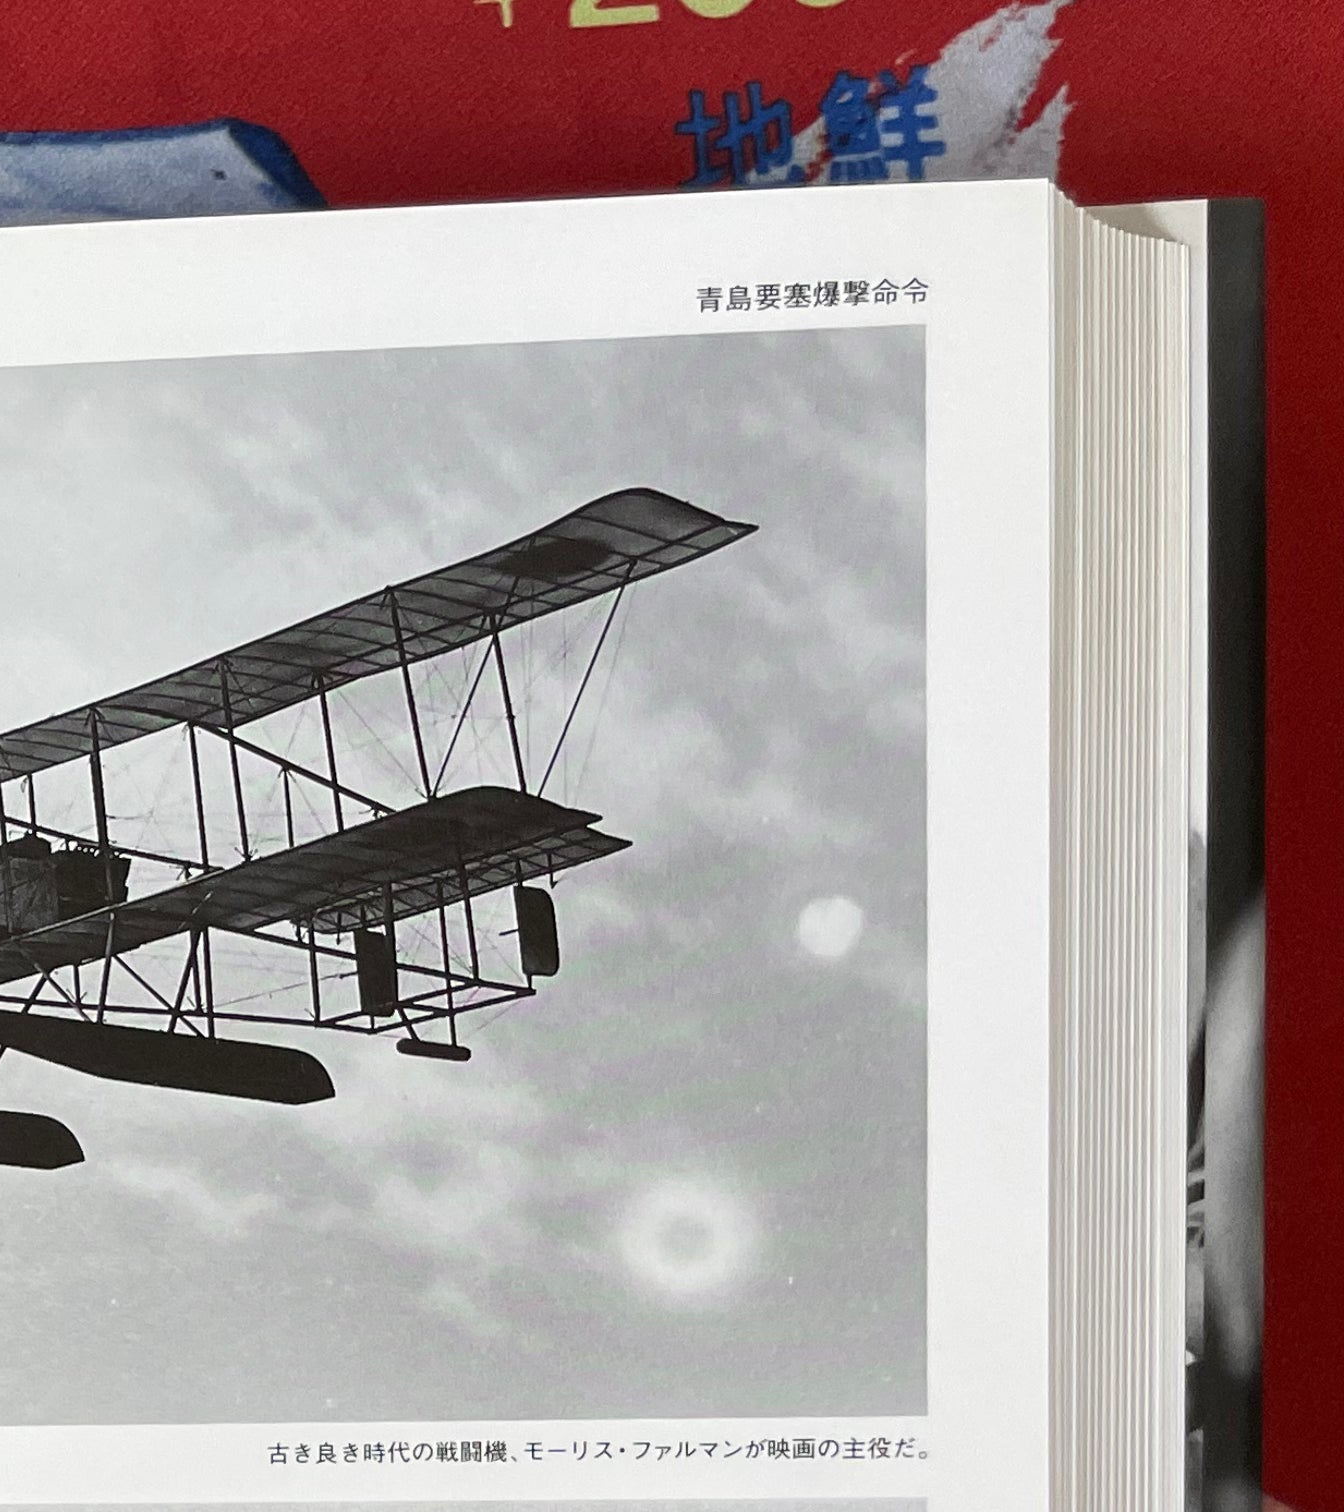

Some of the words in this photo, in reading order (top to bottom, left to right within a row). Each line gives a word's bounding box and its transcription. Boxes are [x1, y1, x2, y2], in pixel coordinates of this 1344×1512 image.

[696, 277, 930, 313] 青島要塞爆撃命令
[267, 1437, 928, 1465] 古き良き時代の戦闘機、モーリス・ファルマンが映画の主役だ。
